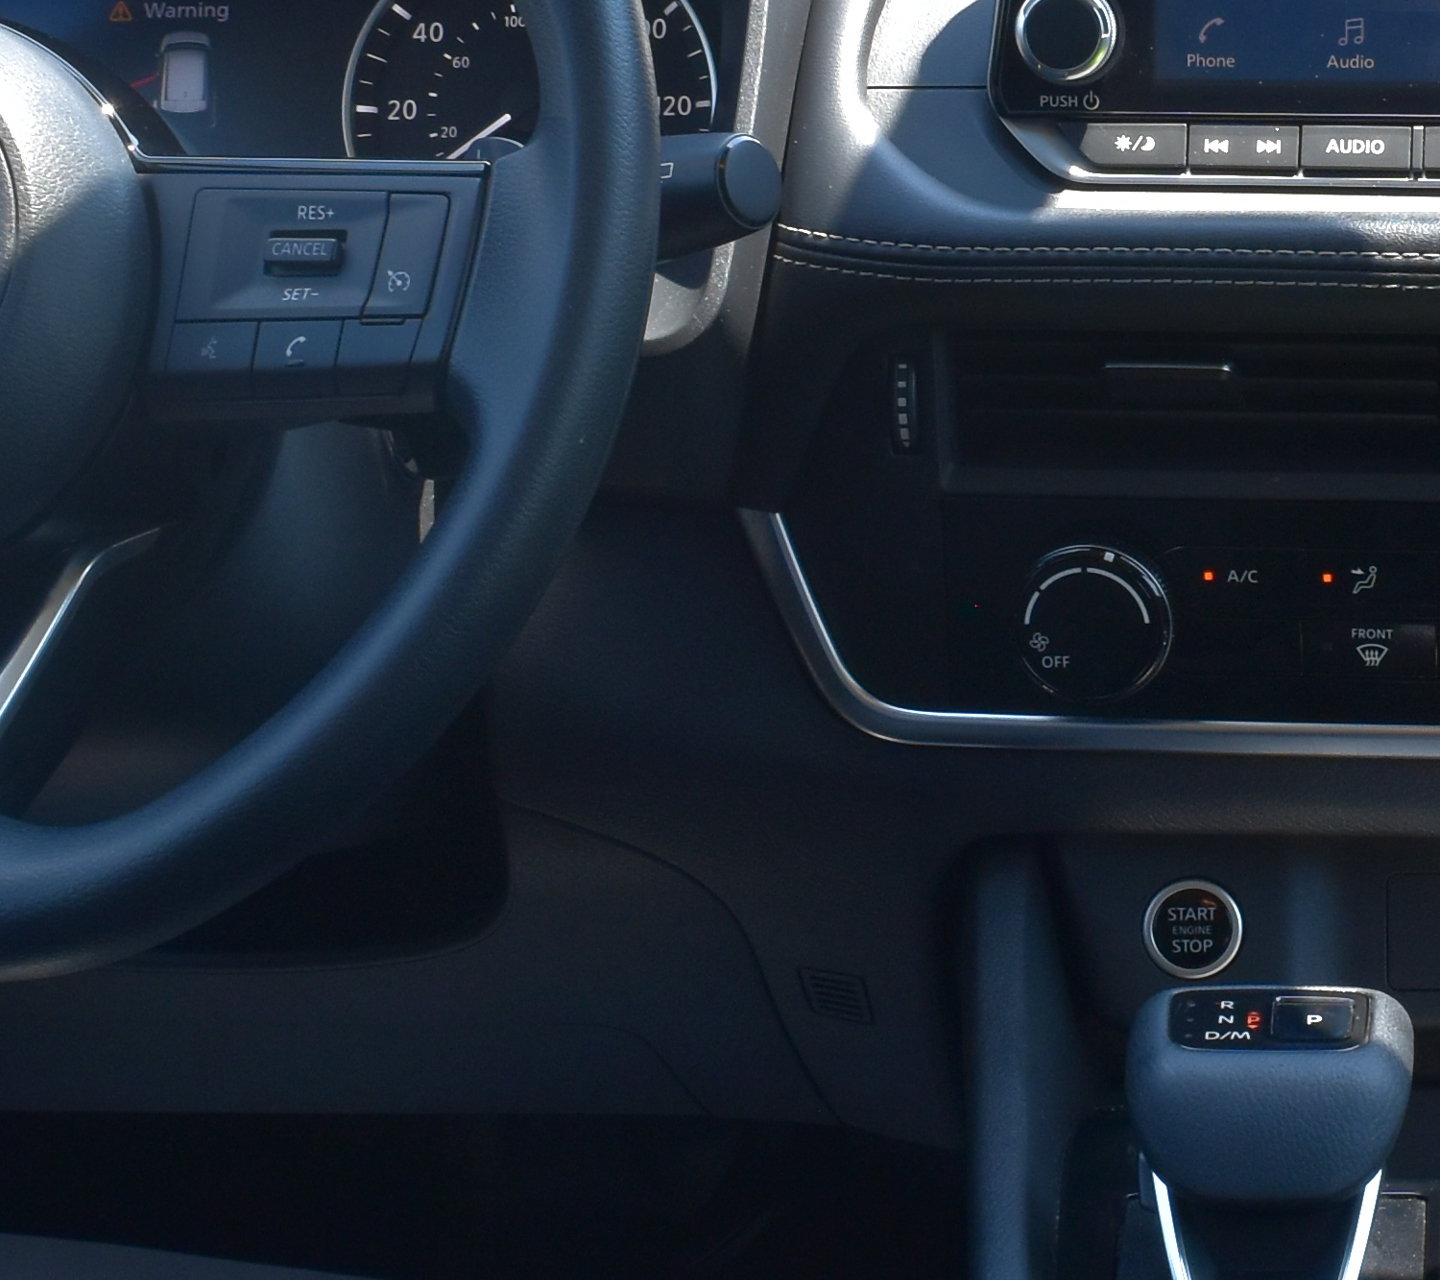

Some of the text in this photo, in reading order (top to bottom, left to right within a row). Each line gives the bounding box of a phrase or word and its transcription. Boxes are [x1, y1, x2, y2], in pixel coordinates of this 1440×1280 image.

[145, 1, 229, 22] Warning
[413, 22, 444, 42] 40
[452, 56, 470, 69] 60
[1187, 52, 1235, 69] Phone
[1327, 53, 1373, 70] Audio
[1040, 92, 1079, 109] PUSH
[387, 100, 417, 120] 20
[441, 126, 457, 138] 20
[1326, 138, 1385, 155] AUDIO
[272, 242, 328, 256] CANCEL
[1228, 570, 1259, 583] A/C
[1351, 629, 1393, 640] FRONT
[1042, 656, 1070, 668] OFF
[1168, 907, 1216, 921] START
[1172, 926, 1212, 935] ENGINE
[1172, 939, 1213, 953] STOP
[1221, 1001, 1234, 1010] R
[1218, 1015, 1234, 1024] N
[1306, 1015, 1322, 1025] P
[1205, 1031, 1251, 1040] D/M
